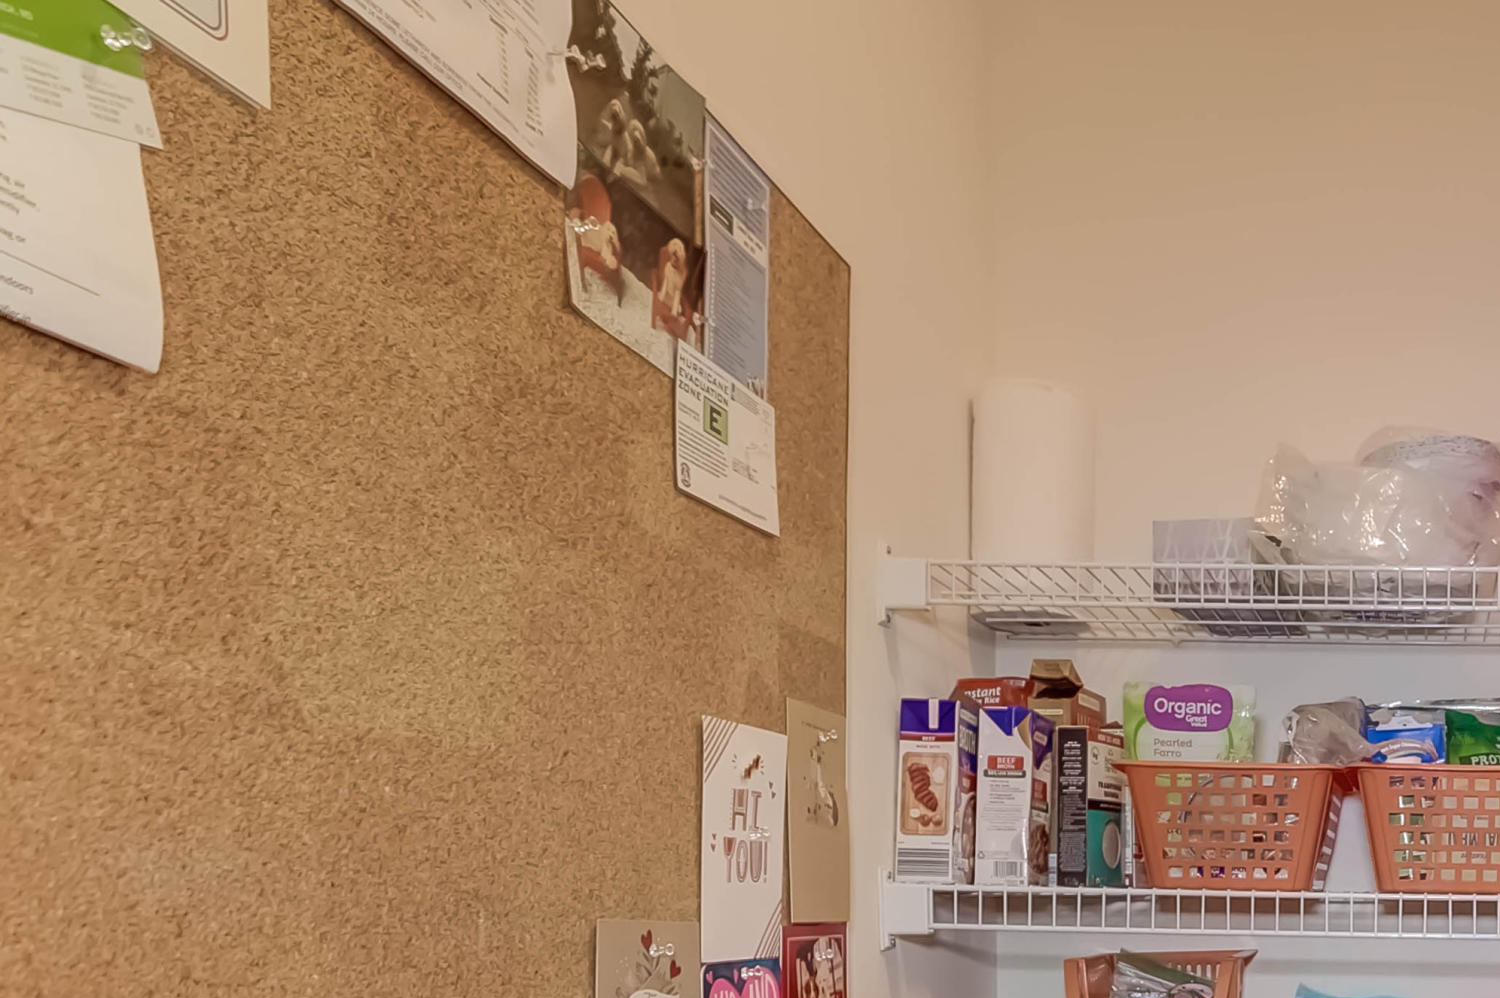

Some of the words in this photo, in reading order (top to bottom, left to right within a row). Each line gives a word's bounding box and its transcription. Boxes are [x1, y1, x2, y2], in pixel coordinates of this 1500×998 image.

[678, 366, 729, 407] EVACUATION
[679, 353, 729, 395] HURRICANE
[678, 379, 702, 402] ZONE
[709, 405, 722, 436] E
[1154, 697, 1222, 718] Organic
[1153, 738, 1192, 748] Pearled
[1153, 748, 1182, 758] Farro
[730, 788, 762, 832] HI
[722, 836, 768, 884] YOU!
